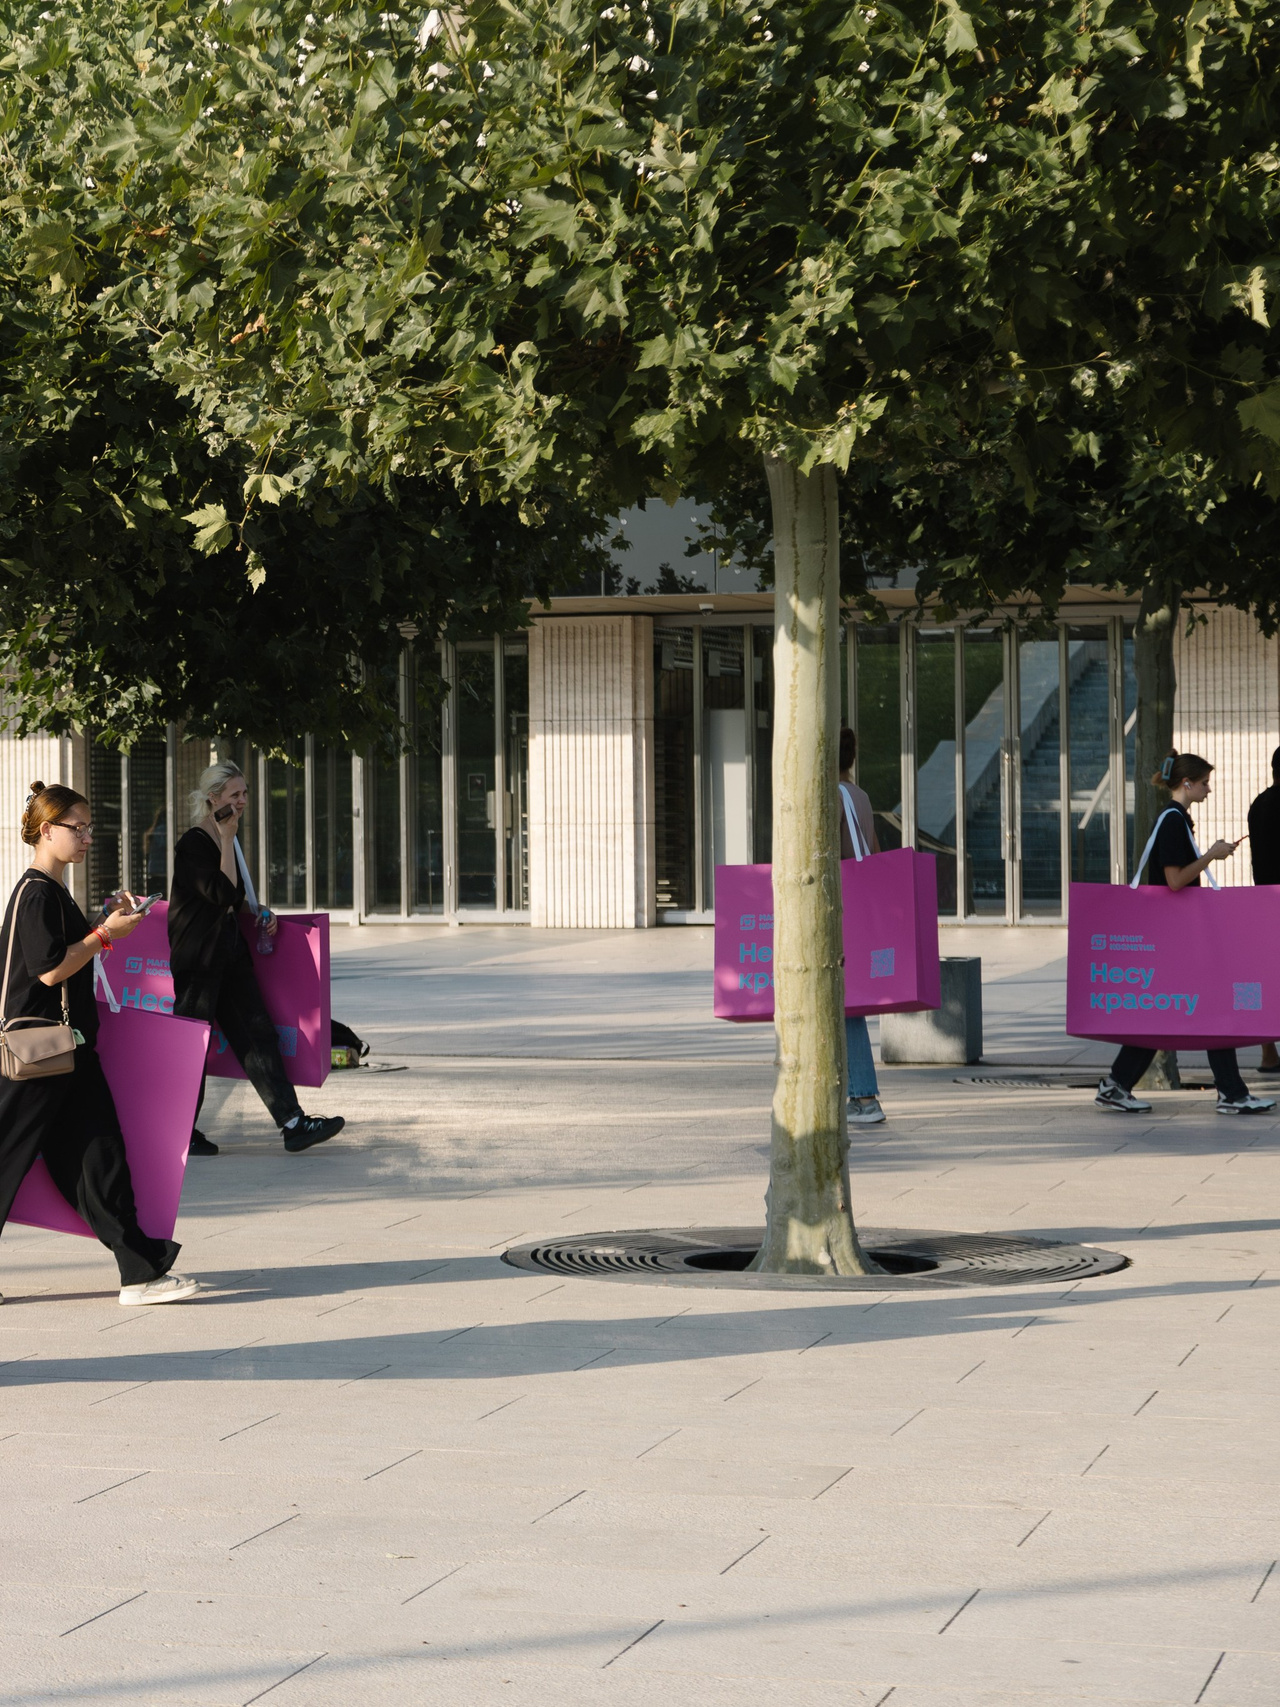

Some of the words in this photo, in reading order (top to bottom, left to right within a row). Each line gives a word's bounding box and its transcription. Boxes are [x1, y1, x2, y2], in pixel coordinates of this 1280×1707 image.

[739, 942, 773, 963] Не
[1090, 962, 1155, 989] Несу
[122, 986, 174, 1013] Нес
[1090, 992, 1200, 1016] красоту
